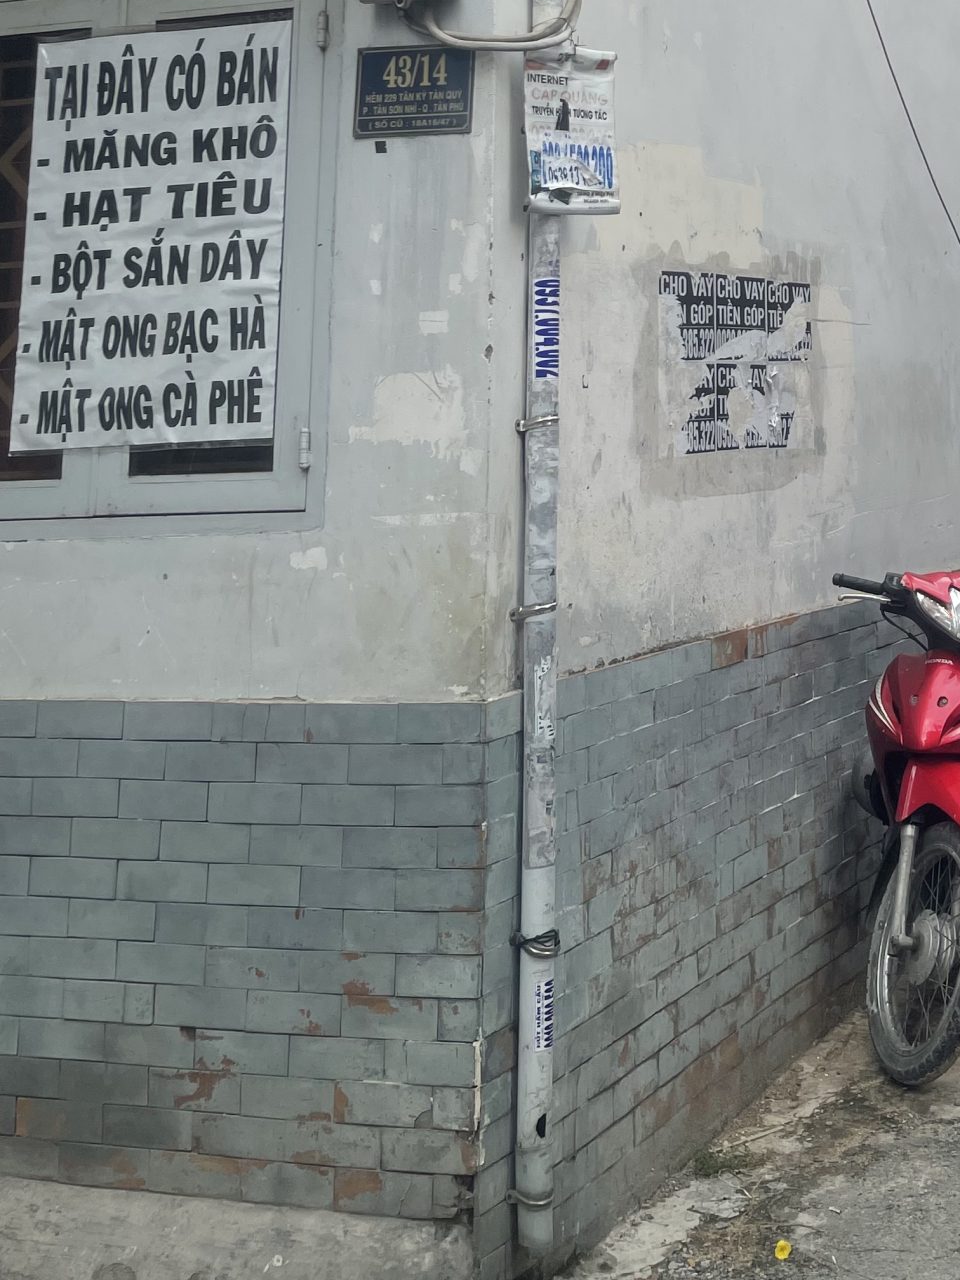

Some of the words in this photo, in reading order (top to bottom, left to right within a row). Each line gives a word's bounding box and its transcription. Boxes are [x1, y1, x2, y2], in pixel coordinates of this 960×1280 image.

[45, 62, 89, 131] TẠI
[97, 43, 157, 115] ĐÂY
[166, 38, 205, 111] CÓ
[217, 34, 279, 106] BÁN
[382, 53, 448, 88] 43/14
[527, 73, 569, 86] INTERNET
[384, 93, 398, 103] 229
[399, 91, 415, 102] TÂN
[428, 89, 445, 100] TÂN
[594, 109, 608, 121] TÁC
[63, 129, 177, 173] MĂNG
[193, 115, 278, 163] KHÔ
[63, 186, 151, 231] HẠT
[167, 171, 272, 219] TIÊU
[51, 241, 112, 300] BỘT
[123, 228, 190, 289] SẮN
[200, 230, 268, 284] DÂY
[660, 274, 687, 297] CHO
[690, 276, 714, 297] VAY
[717, 277, 741, 299] CHO
[744, 280, 765, 301] VAY
[768, 283, 789, 304] CHO
[690, 300, 713, 324] GÓP
[717, 299, 741, 325] TIỀN
[744, 303, 765, 327] GÓP
[768, 303, 785, 328] TIỀ
[38, 307, 95, 370] MẬT
[102, 313, 157, 360] ONG
[162, 308, 218, 363] BẠC
[229, 295, 266, 350] HÀ
[752, 368, 766, 388] AY
[36, 378, 92, 443] MẬT
[98, 384, 153, 431] ONG
[162, 371, 197, 428] CÀ
[209, 367, 263, 425] PHÊ
